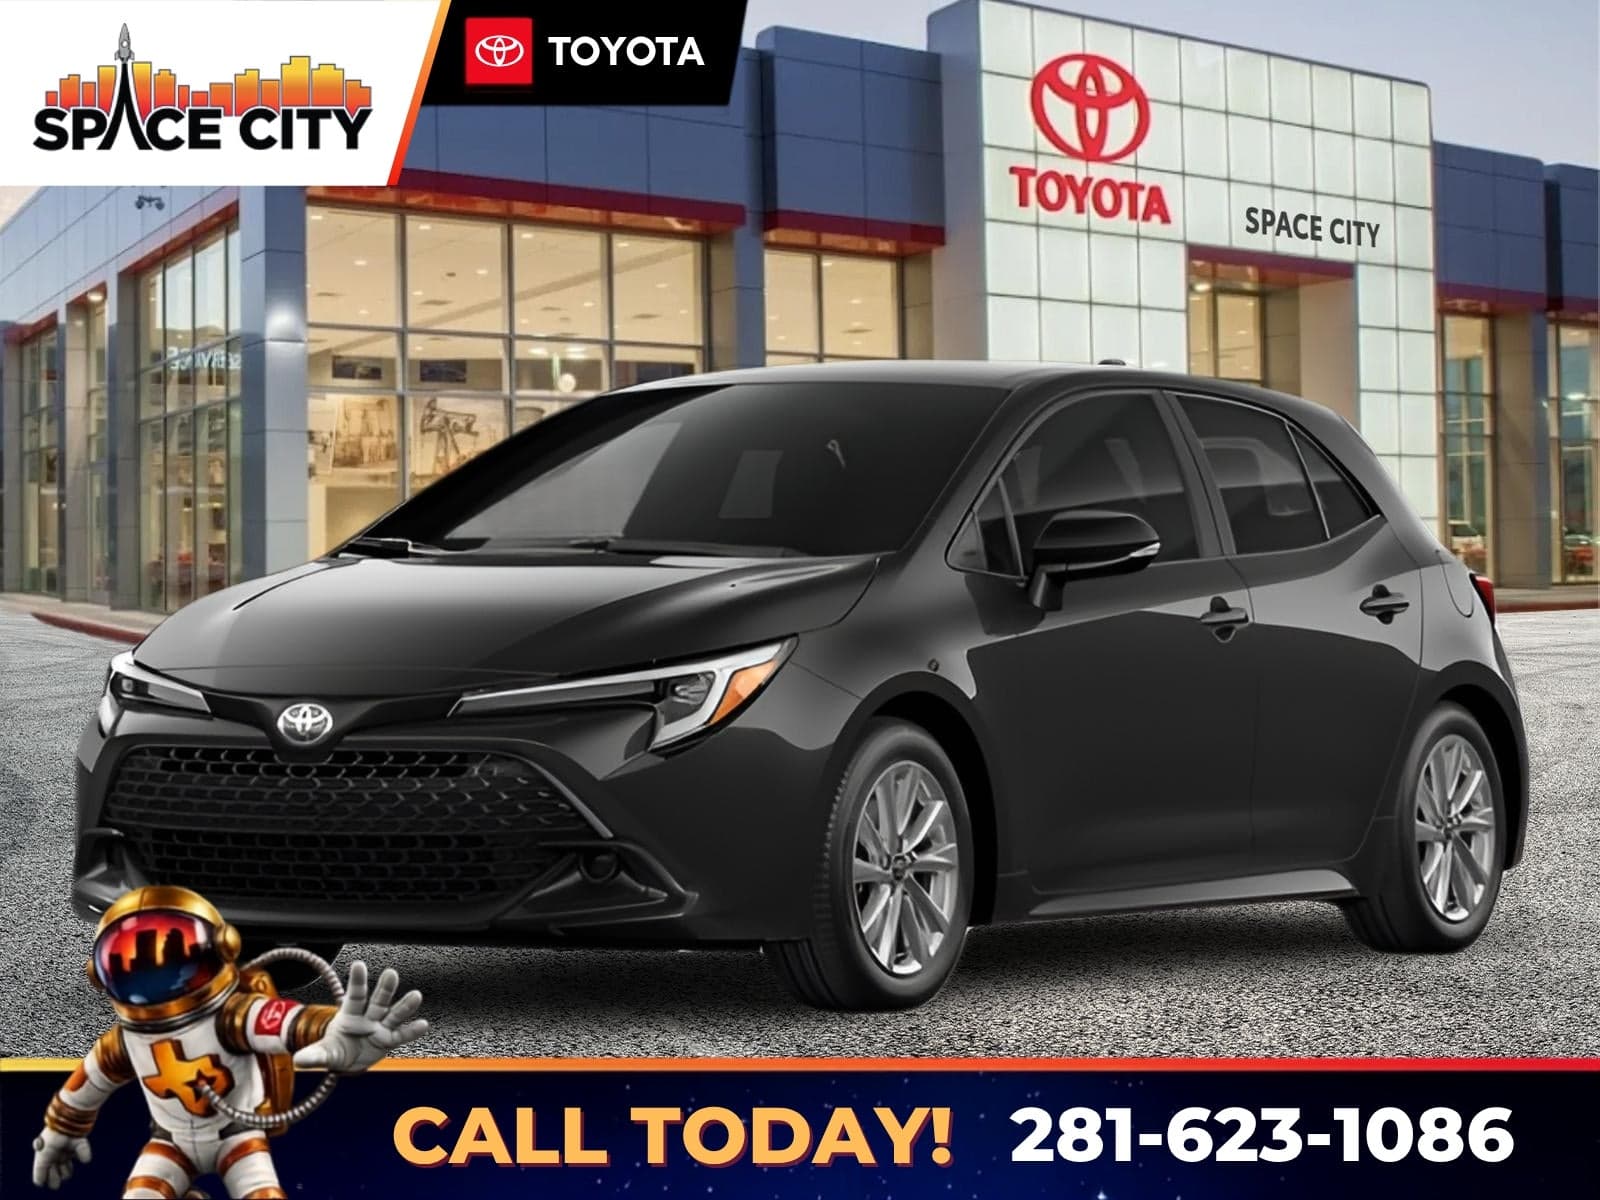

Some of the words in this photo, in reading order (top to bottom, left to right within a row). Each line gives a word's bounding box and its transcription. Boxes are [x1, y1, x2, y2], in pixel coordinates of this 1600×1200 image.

[1009, 166, 1172, 225] TOYOTA
[1245, 206, 1323, 242] SPACE
[1329, 217, 1381, 248] CITY
